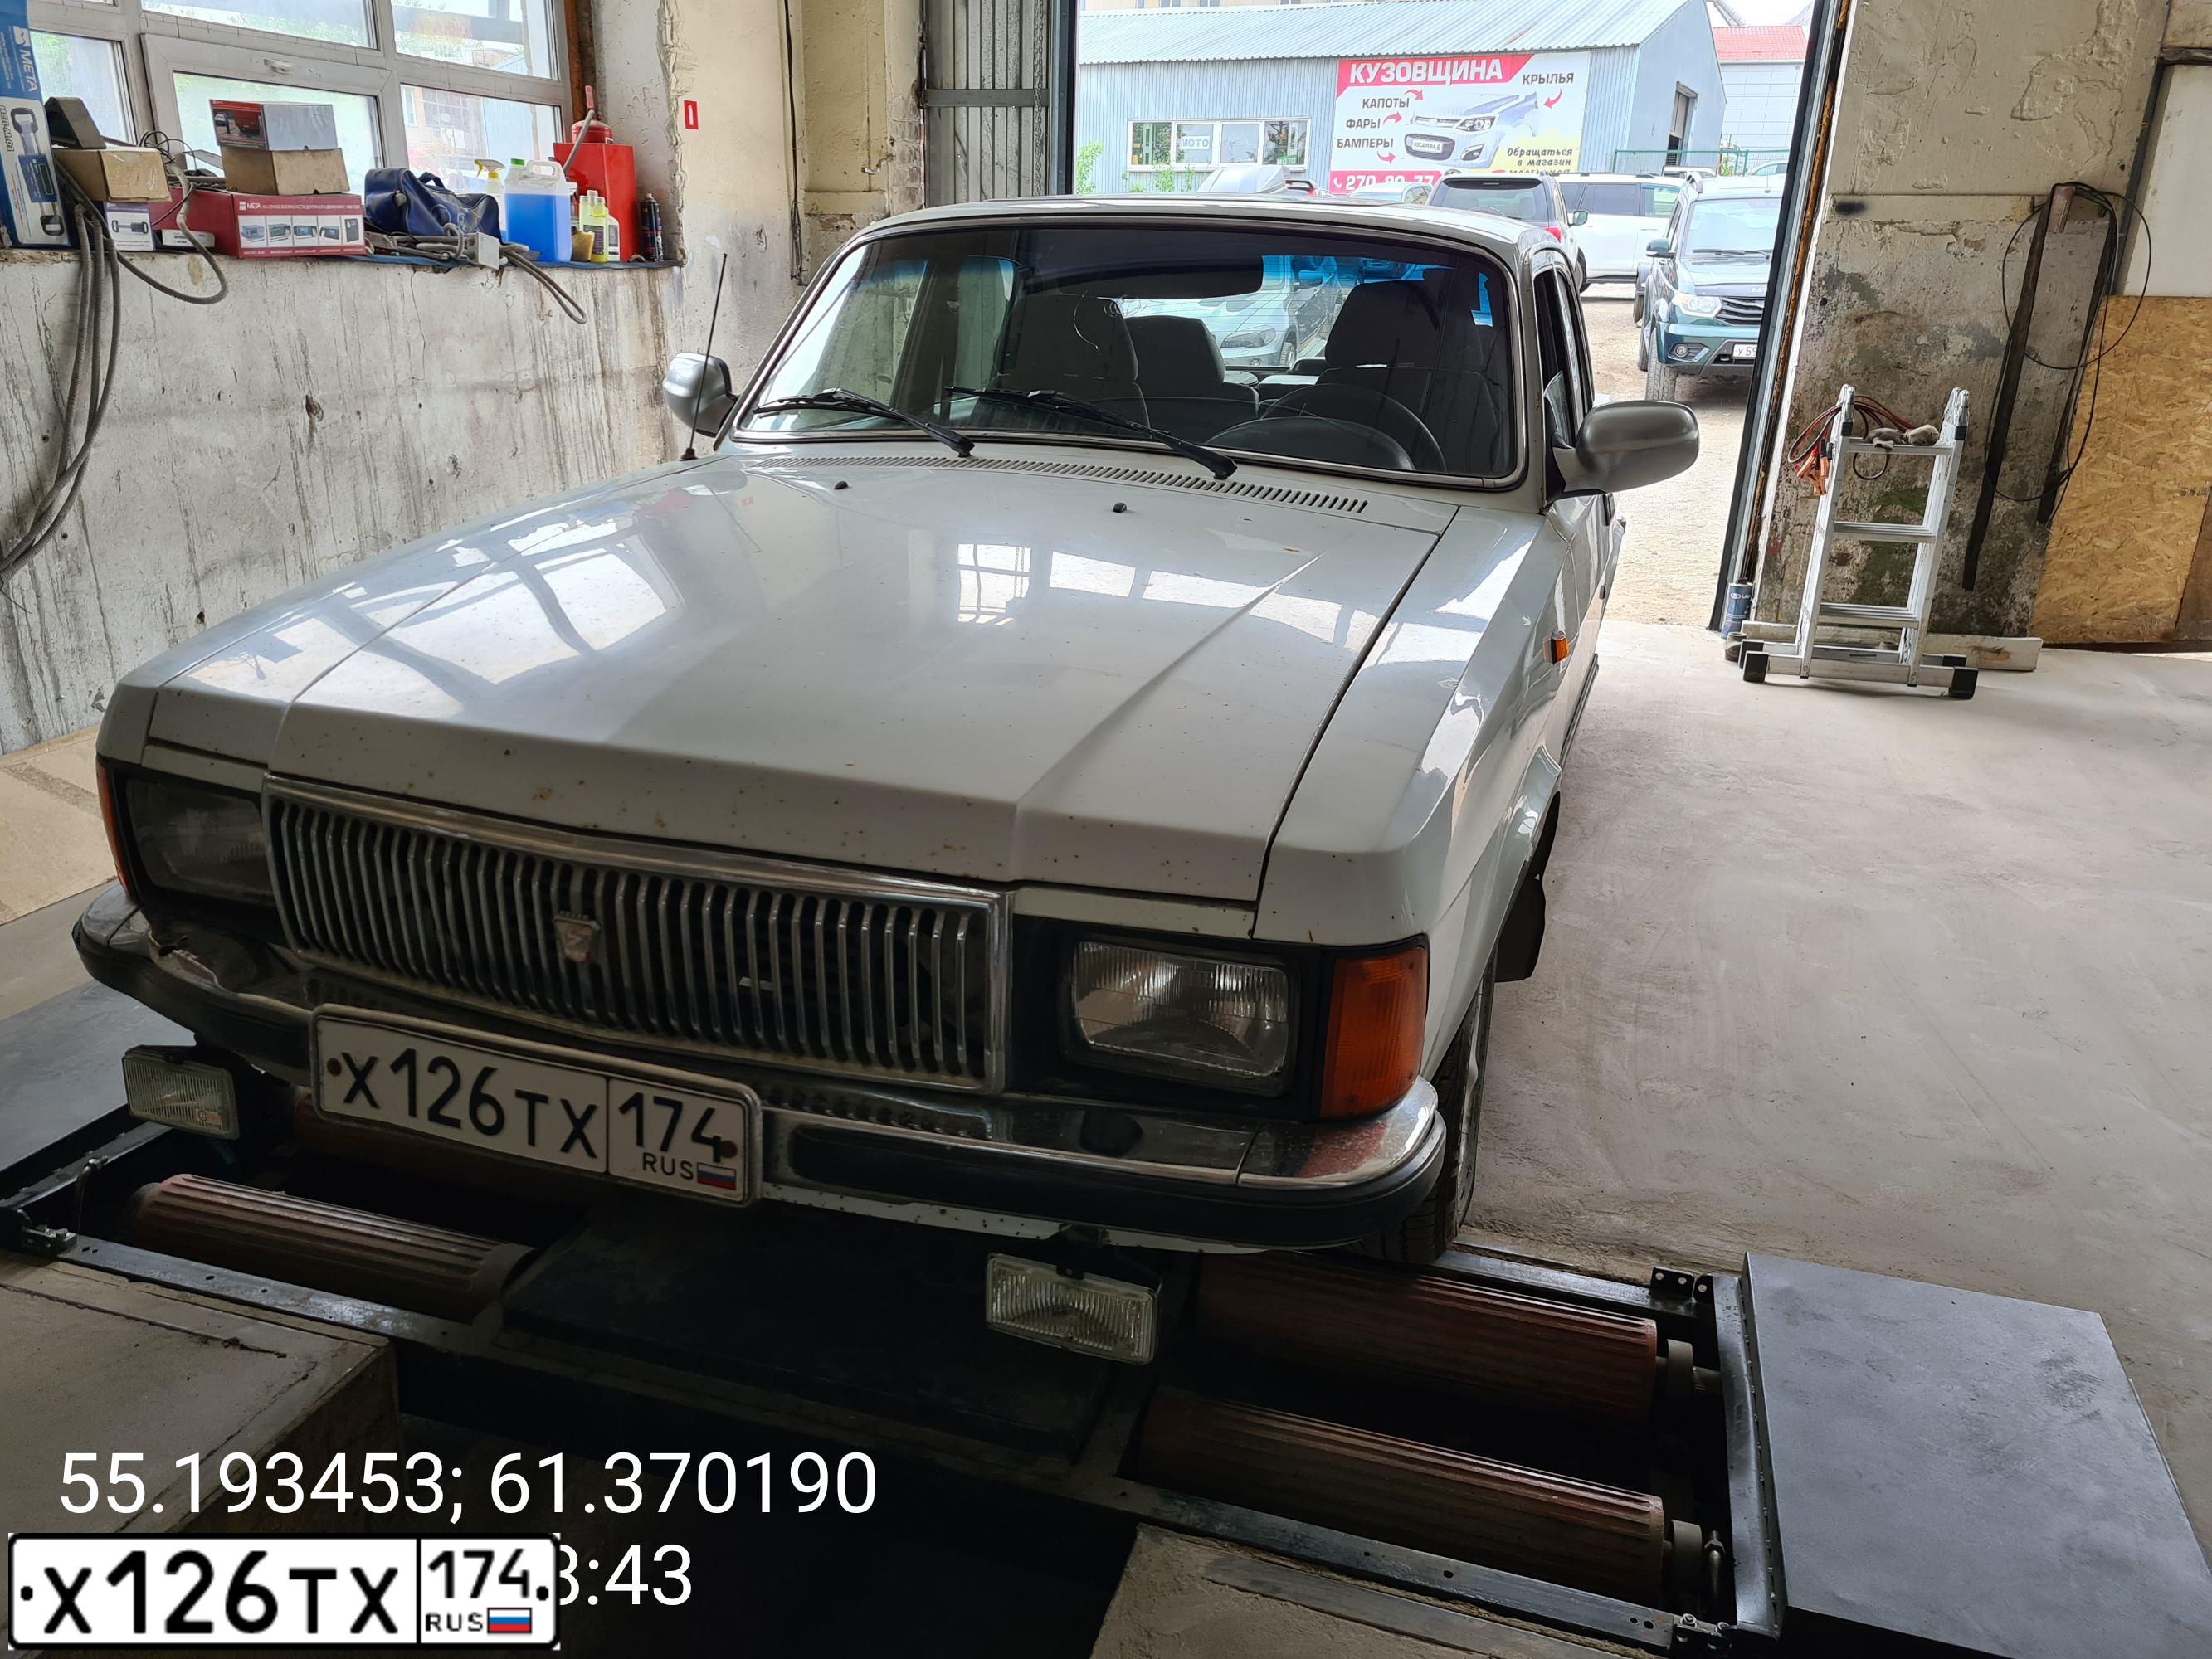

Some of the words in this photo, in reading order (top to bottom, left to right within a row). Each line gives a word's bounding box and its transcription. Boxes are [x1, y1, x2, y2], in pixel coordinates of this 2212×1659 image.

[1350, 59, 1503, 85] КУЗОВЩИНА
[1523, 73, 1574, 85] КРЫЛЬЯ
[1362, 98, 1410, 109] КАПОТЫ
[1346, 119, 1381, 129] ФАРЫ
[1181, 139, 1209, 148] МОТО
[1337, 138, 1394, 148] БАМПЕРЫ
[1507, 147, 1573, 158] Обращаться
[1527, 158, 1571, 167] магазин
[341, 1048, 599, 1159] Х126ТХ
[618, 1092, 722, 1163] 174
[641, 1153, 694, 1180] RUS
